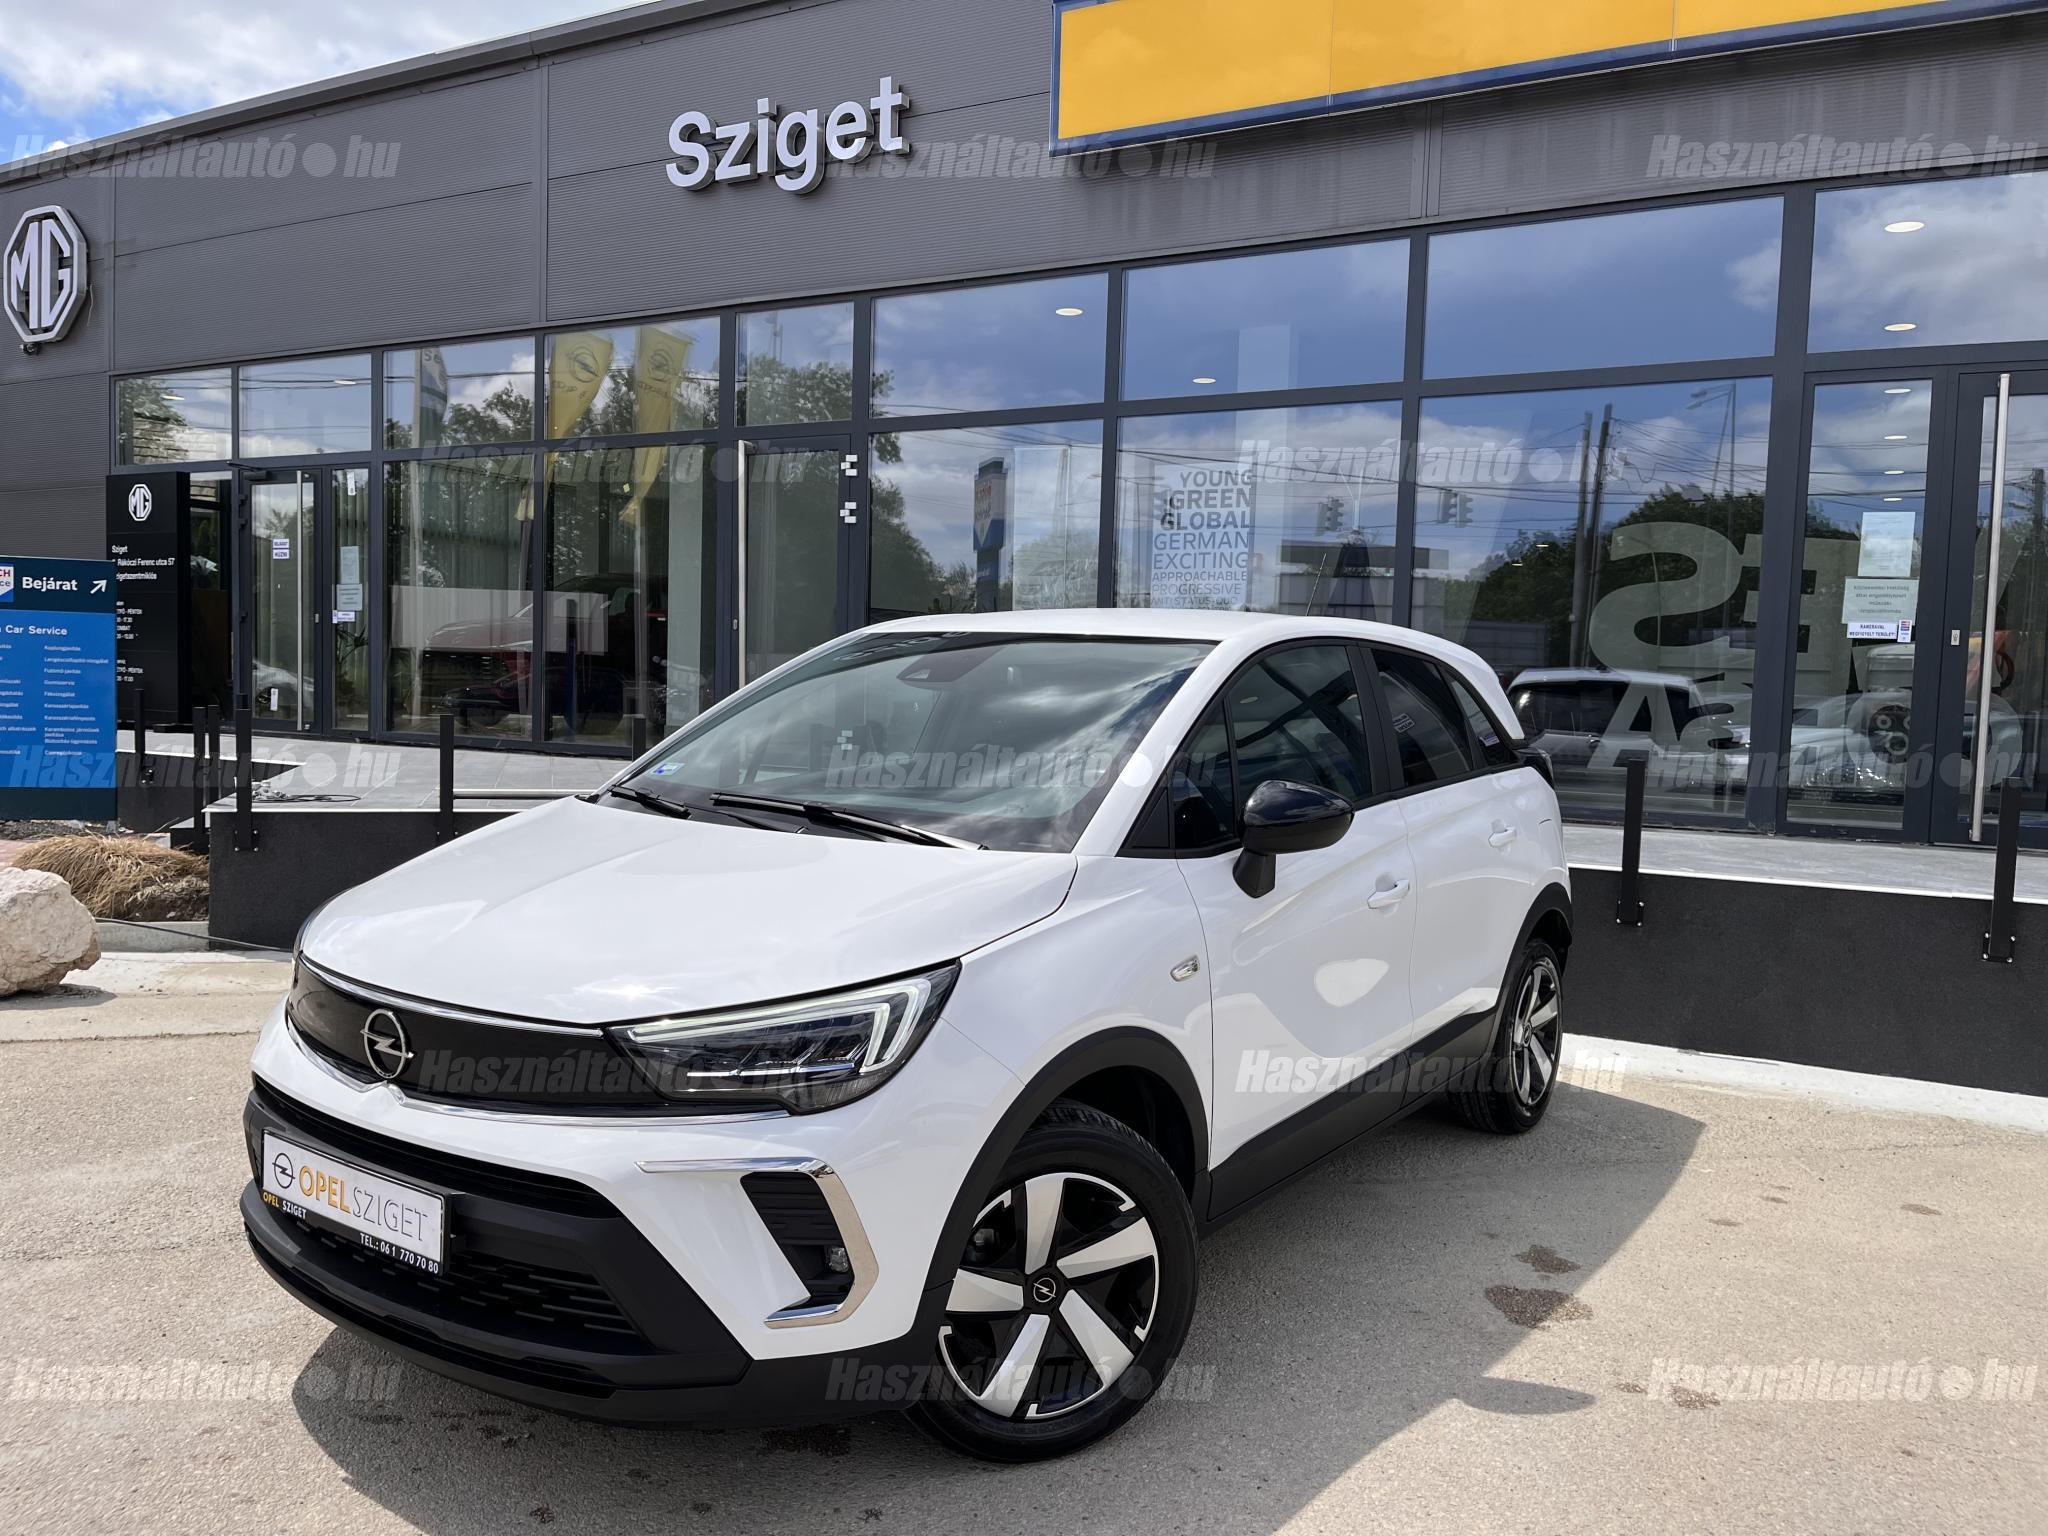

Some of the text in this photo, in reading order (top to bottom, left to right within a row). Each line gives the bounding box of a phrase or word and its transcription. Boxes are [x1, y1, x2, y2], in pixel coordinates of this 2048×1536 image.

[666, 76, 910, 193] Sziget
[9, 217, 73, 331] MG
[1180, 469, 1253, 488] YOUNG
[1169, 487, 1251, 510] GREEN
[1160, 510, 1250, 531] GLOBAL
[111, 545, 128, 555] Sziget
[1154, 531, 1249, 551] GERMAN
[1153, 552, 1249, 570] EXCITING
[22, 576, 78, 592] Bejárat
[1152, 570, 1247, 582] APPROACHABLE
[1152, 583, 1242, 596] PROGRESSIVE
[5, 624, 24, 634] Car
[28, 625, 68, 635] Service
[263, 1191, 307, 1220] OPEL SZIGET
[359, 1232, 379, 1250] TEL.:
[400, 1249, 415, 1265] 770
[416, 1255, 426, 1269] 70
[428, 1261, 439, 1274] 80
